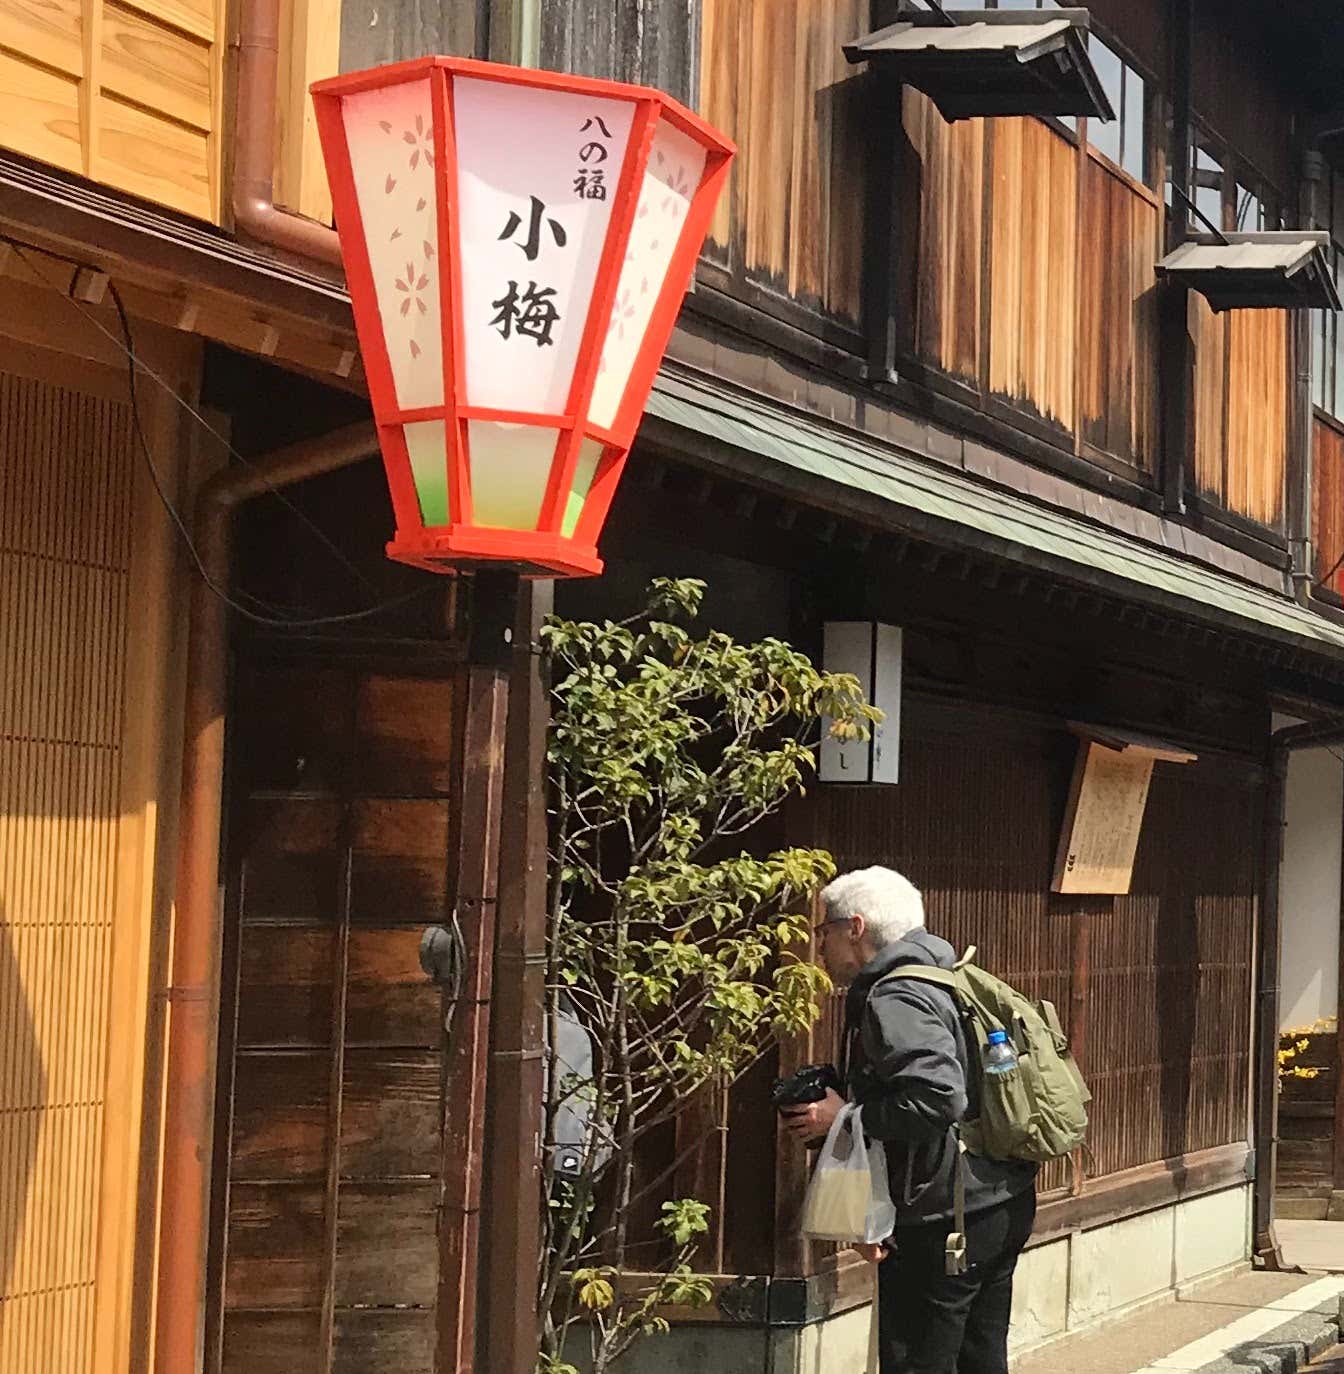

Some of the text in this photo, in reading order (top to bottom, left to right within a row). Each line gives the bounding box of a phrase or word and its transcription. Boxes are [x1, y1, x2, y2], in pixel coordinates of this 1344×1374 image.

[573, 116, 612, 201] 八の福
[488, 196, 567, 347] 小梅
